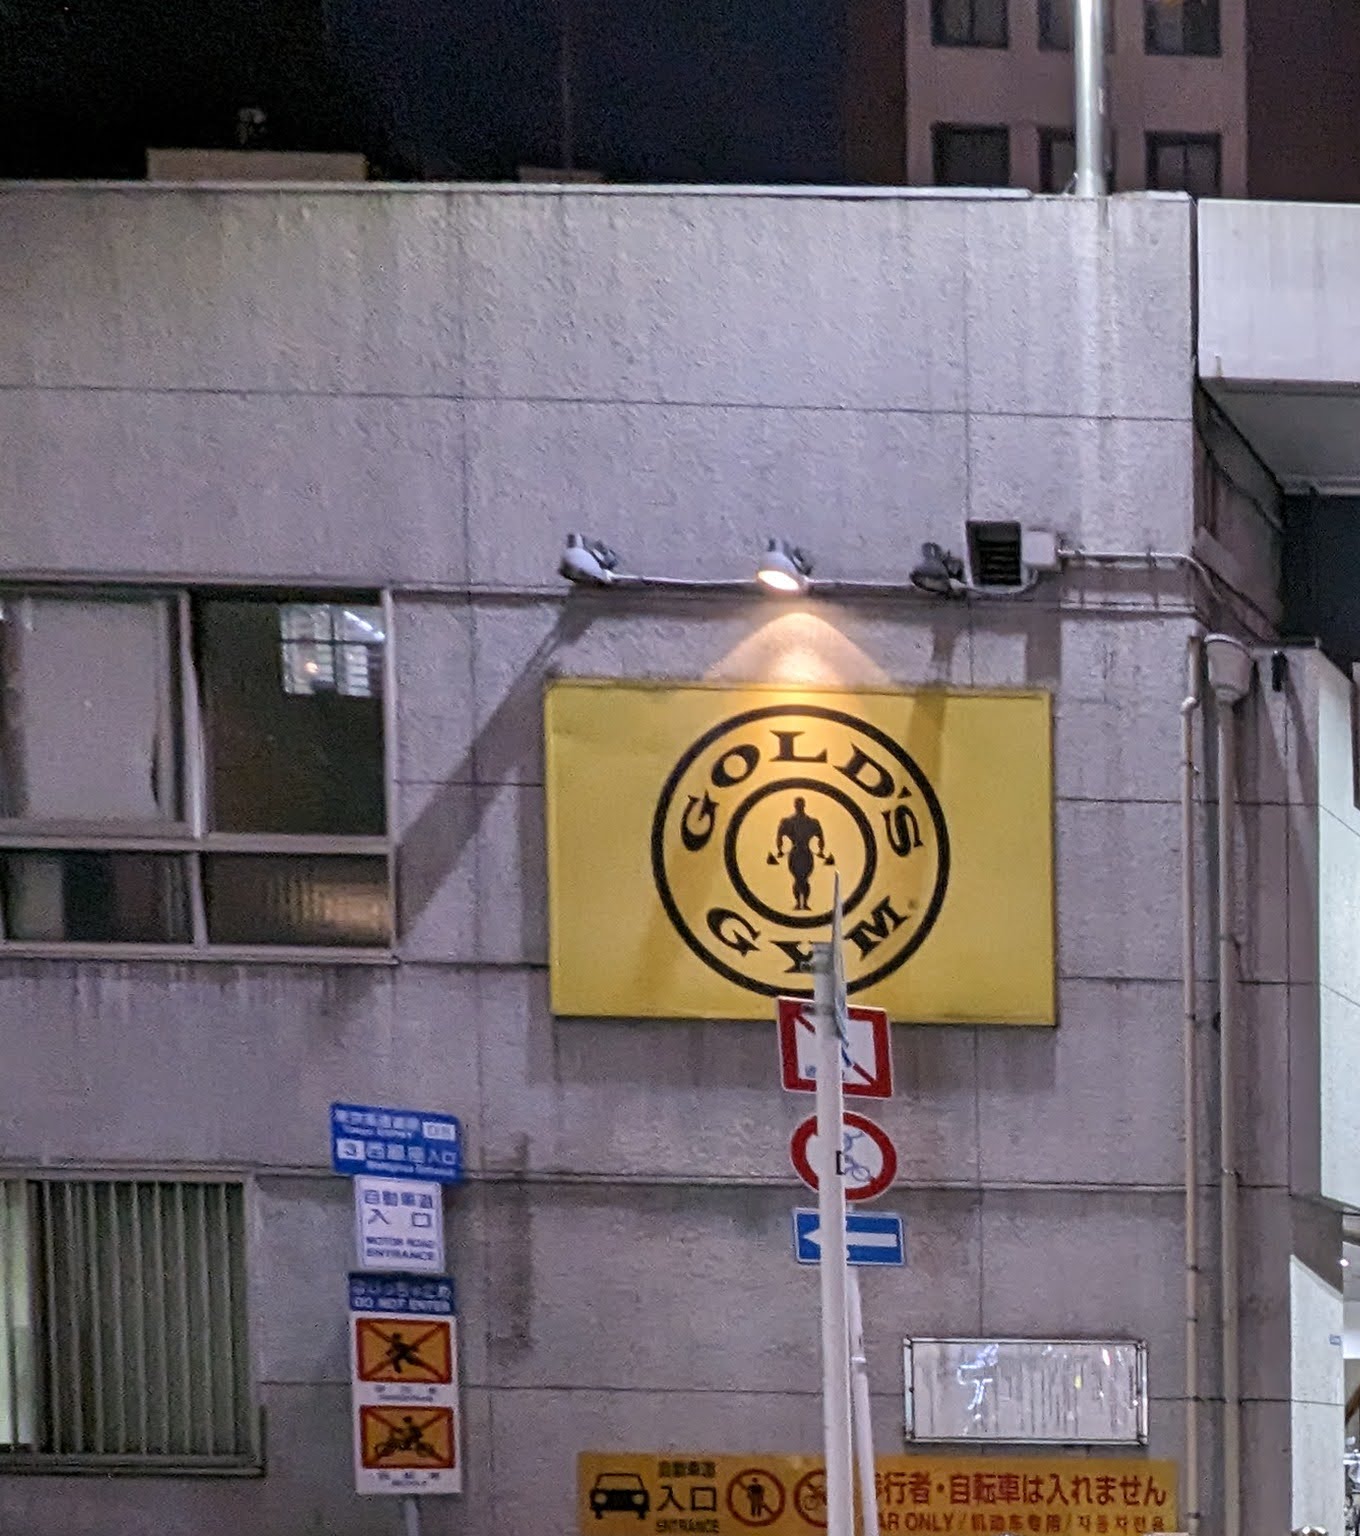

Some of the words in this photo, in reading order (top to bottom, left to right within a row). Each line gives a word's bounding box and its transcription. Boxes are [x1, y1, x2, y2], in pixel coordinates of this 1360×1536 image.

[680, 730, 923, 857] GOLD'S
[706, 896, 911, 974] GYM
[656, 1485, 717, 1511] 入口
[878, 1512, 899, 1531] AR
[905, 1512, 953, 1532] ONLY
